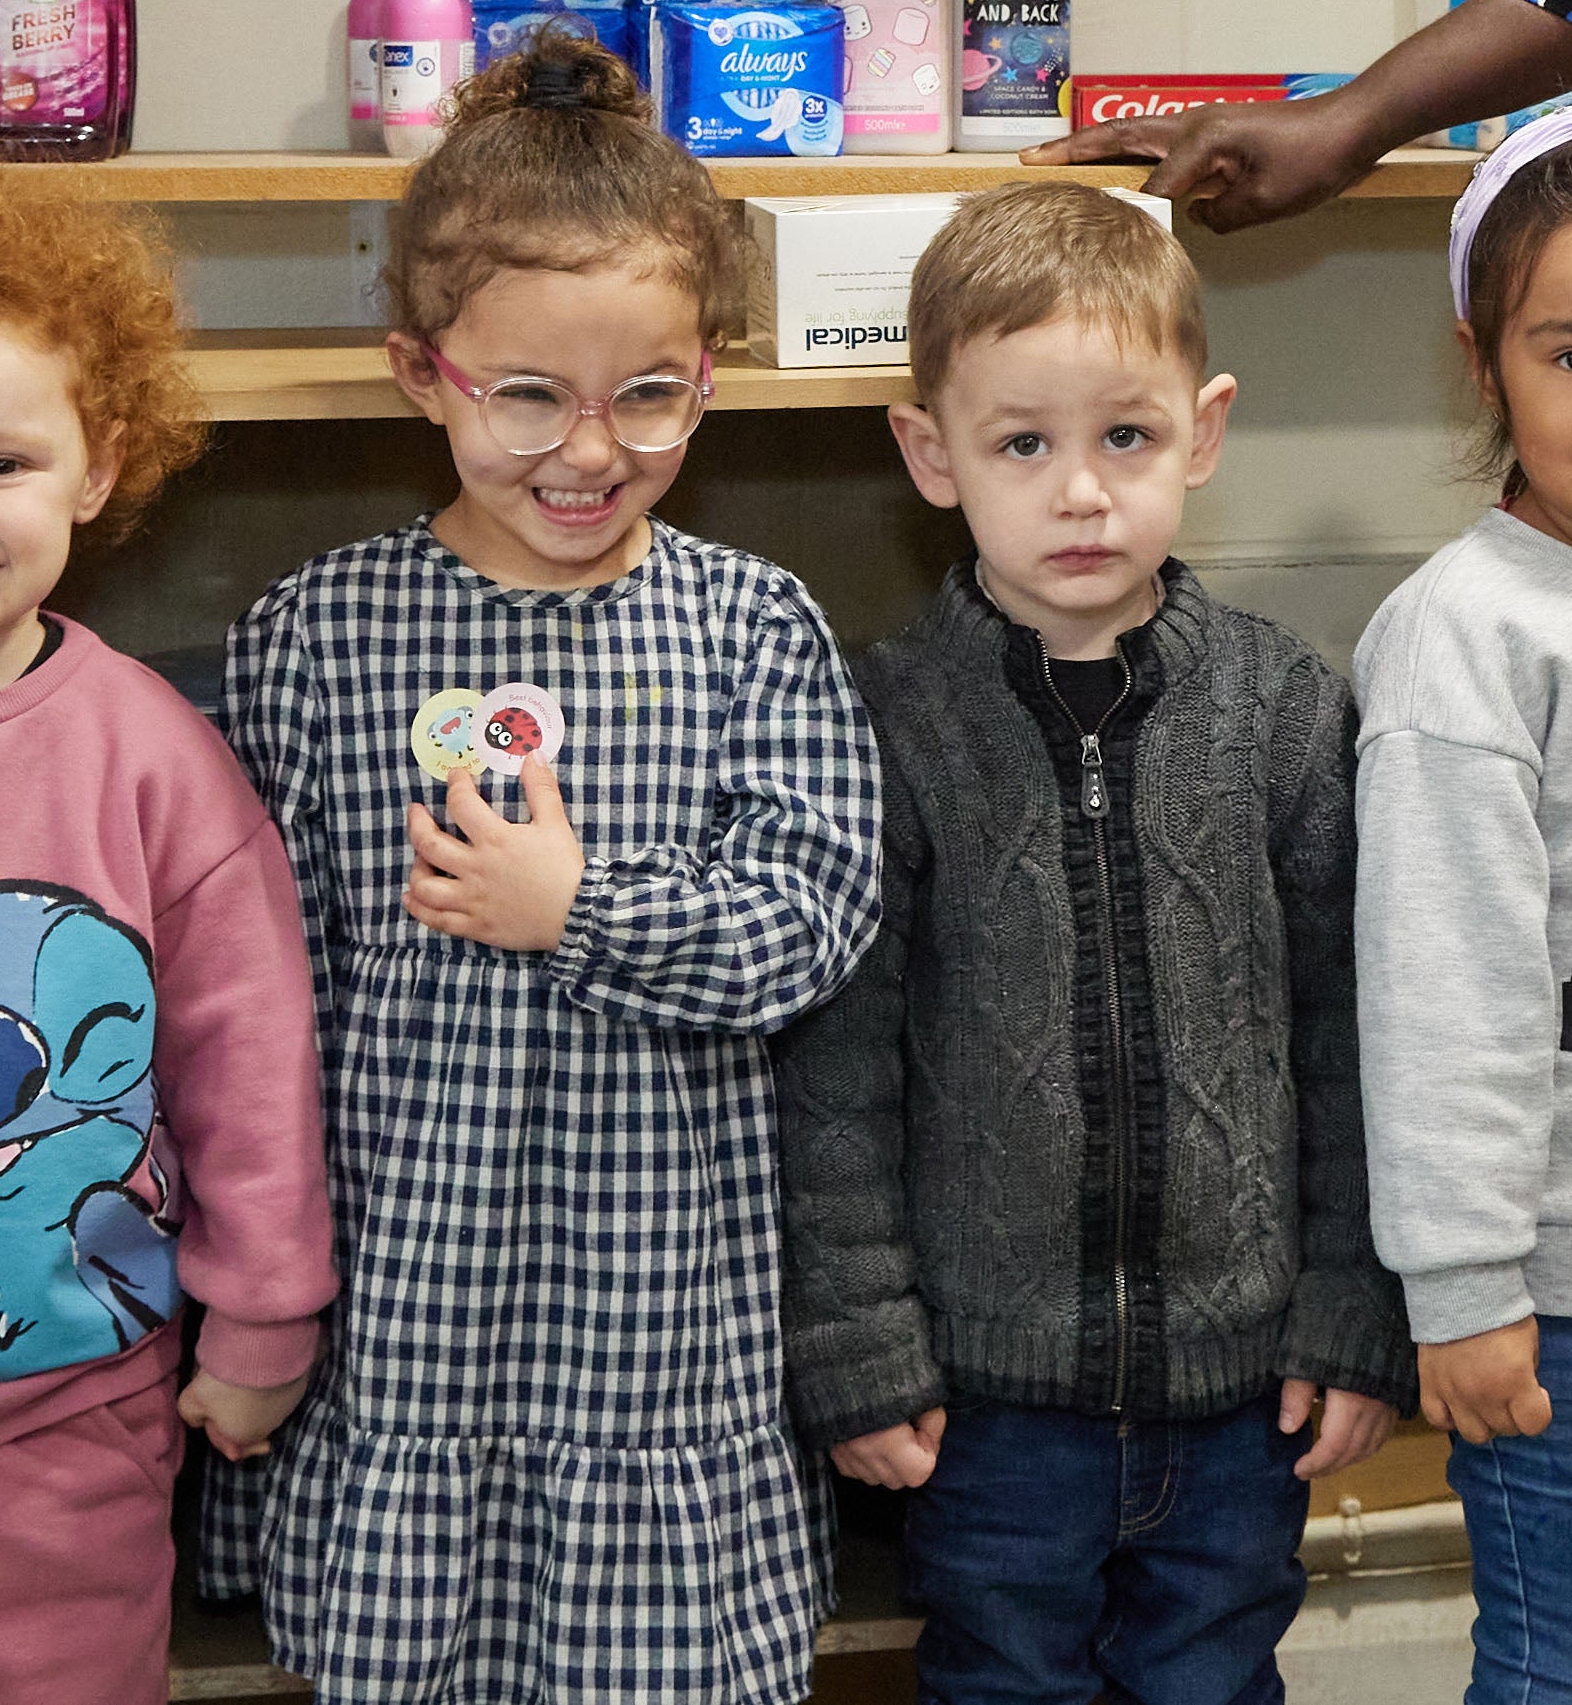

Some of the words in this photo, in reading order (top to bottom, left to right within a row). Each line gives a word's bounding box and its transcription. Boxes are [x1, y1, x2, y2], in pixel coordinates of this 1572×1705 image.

[12, 4, 76, 33] FRESH
[977, 4, 1011, 22] AND
[1021, 4, 1059, 22] BACK
[12, 24, 75, 52] BERRY
[386, 52, 409, 62] anex
[720, 43, 808, 82] always
[805, 97, 825, 114] 3x
[990, 93, 1023, 101] COCONUT
[1025, 93, 1049, 101] CREAM
[687, 116, 703, 140] 3
[804, 313, 825, 328] life
[826, 311, 845, 327] for
[847, 305, 908, 324] supplying
[805, 325, 907, 352] medical
